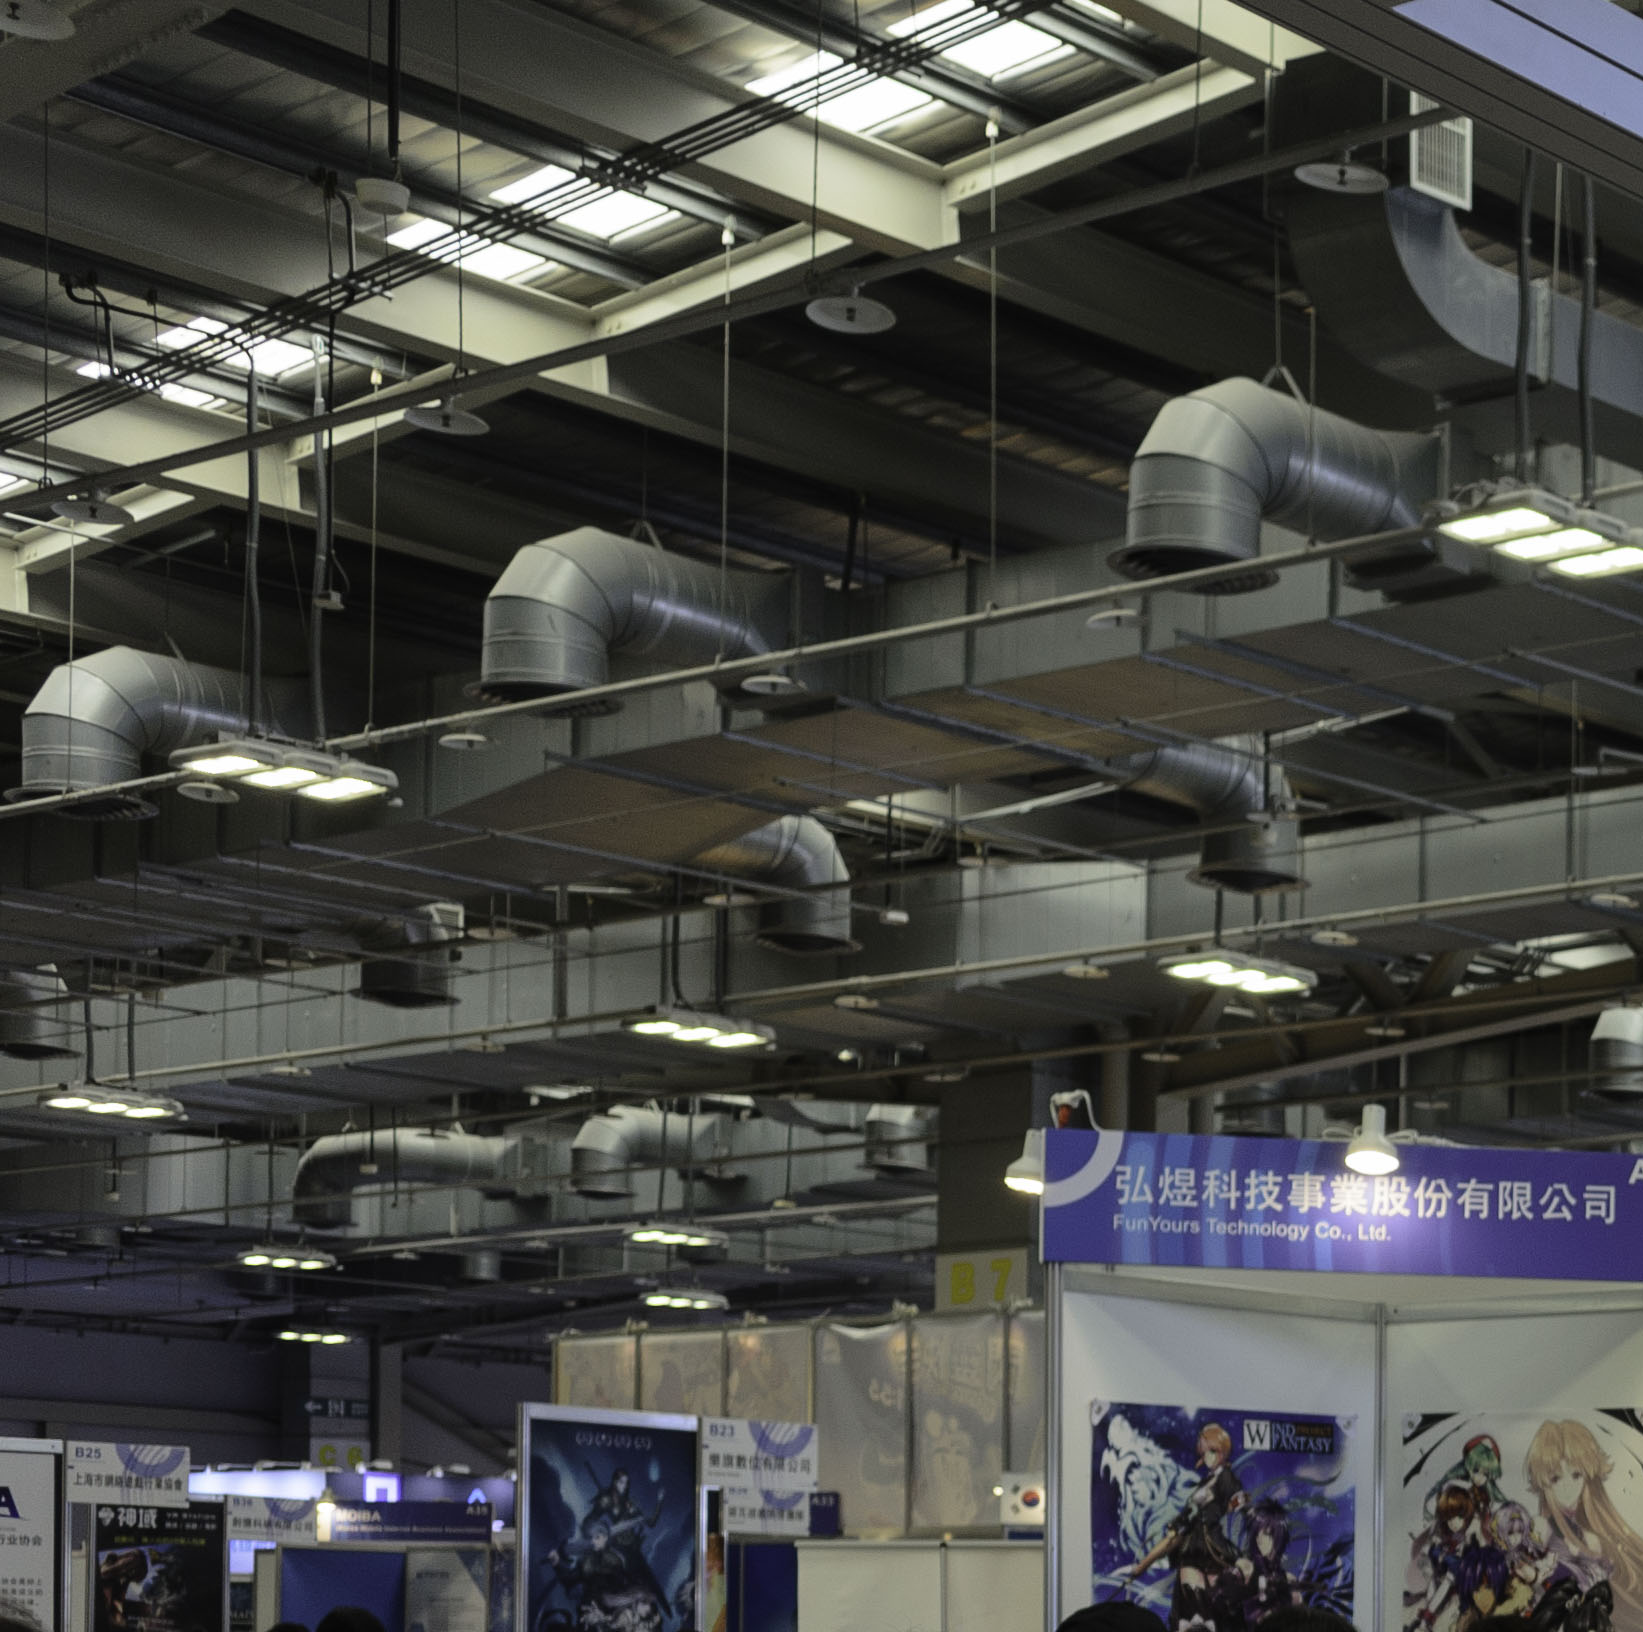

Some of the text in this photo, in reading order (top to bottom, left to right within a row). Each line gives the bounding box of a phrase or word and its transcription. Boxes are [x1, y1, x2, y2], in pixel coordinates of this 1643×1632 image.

[1113, 1163, 1617, 1224] 弘煜科技事業股份有限公司
[1112, 1214, 1391, 1242] FunYours Technology Co., Ltd.
[75, 1448, 102, 1459] B25
[1272, 1435, 1333, 1453] FANTASY
